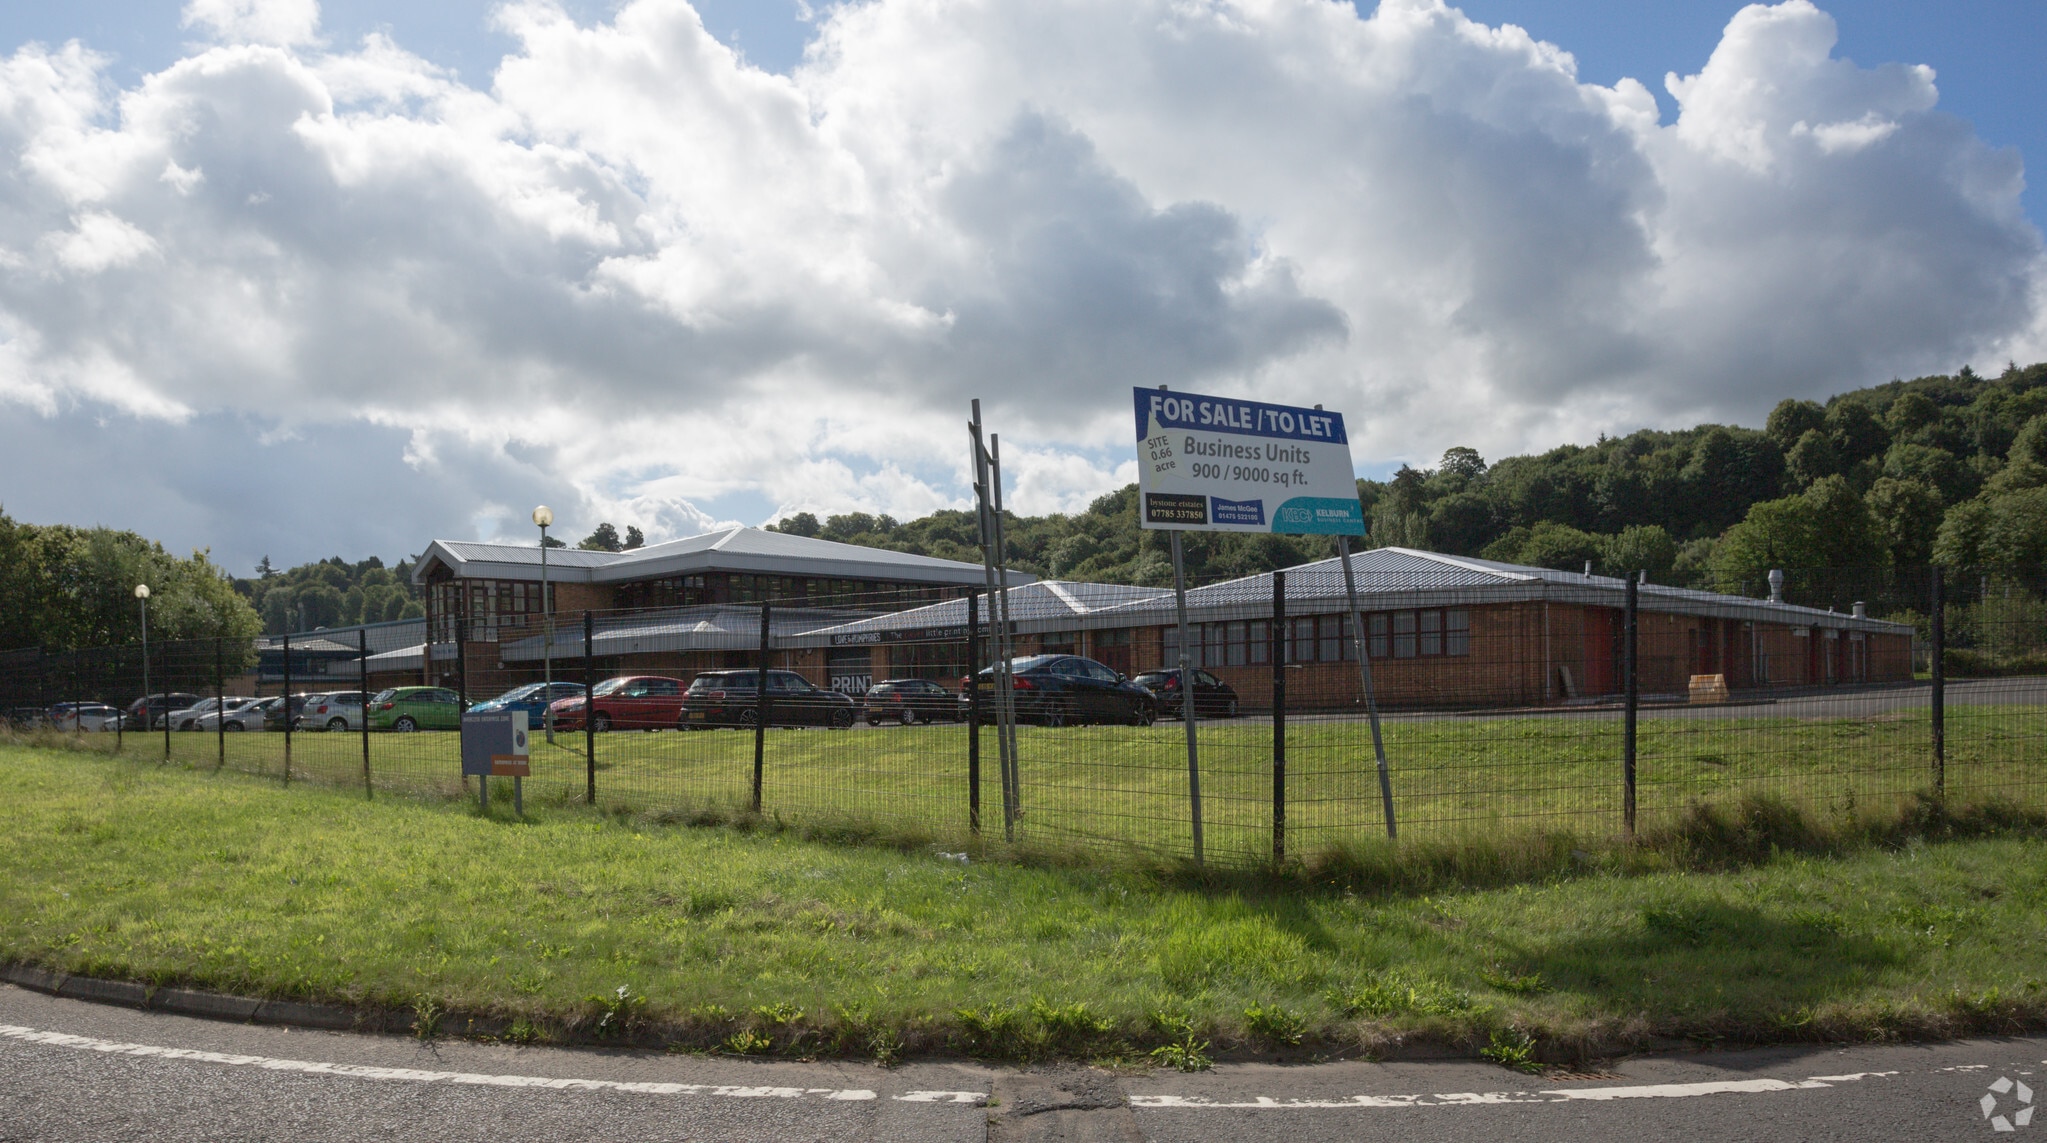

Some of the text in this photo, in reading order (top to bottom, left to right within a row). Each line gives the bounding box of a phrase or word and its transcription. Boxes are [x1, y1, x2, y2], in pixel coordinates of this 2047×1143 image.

[1150, 395, 1196, 424] FOR
[1199, 401, 1253, 429] SALE
[1265, 409, 1295, 433] TO
[1298, 413, 1332, 438] LET
[1147, 435, 1169, 450] SITE
[1151, 447, 1173, 461] 0.66
[1184, 436, 1311, 464] Business Units
[1155, 461, 1176, 473] acre
[1192, 462, 1308, 488] 900 / 9000 sq ft.
[1151, 508, 1204, 519] 07785 337850
[1217, 503, 1258, 513] James McGee
[1315, 509, 1350, 518] KELBURN
[890, 631, 903, 640] The
[925, 628, 942, 637] little
[944, 626, 970, 637] printin
